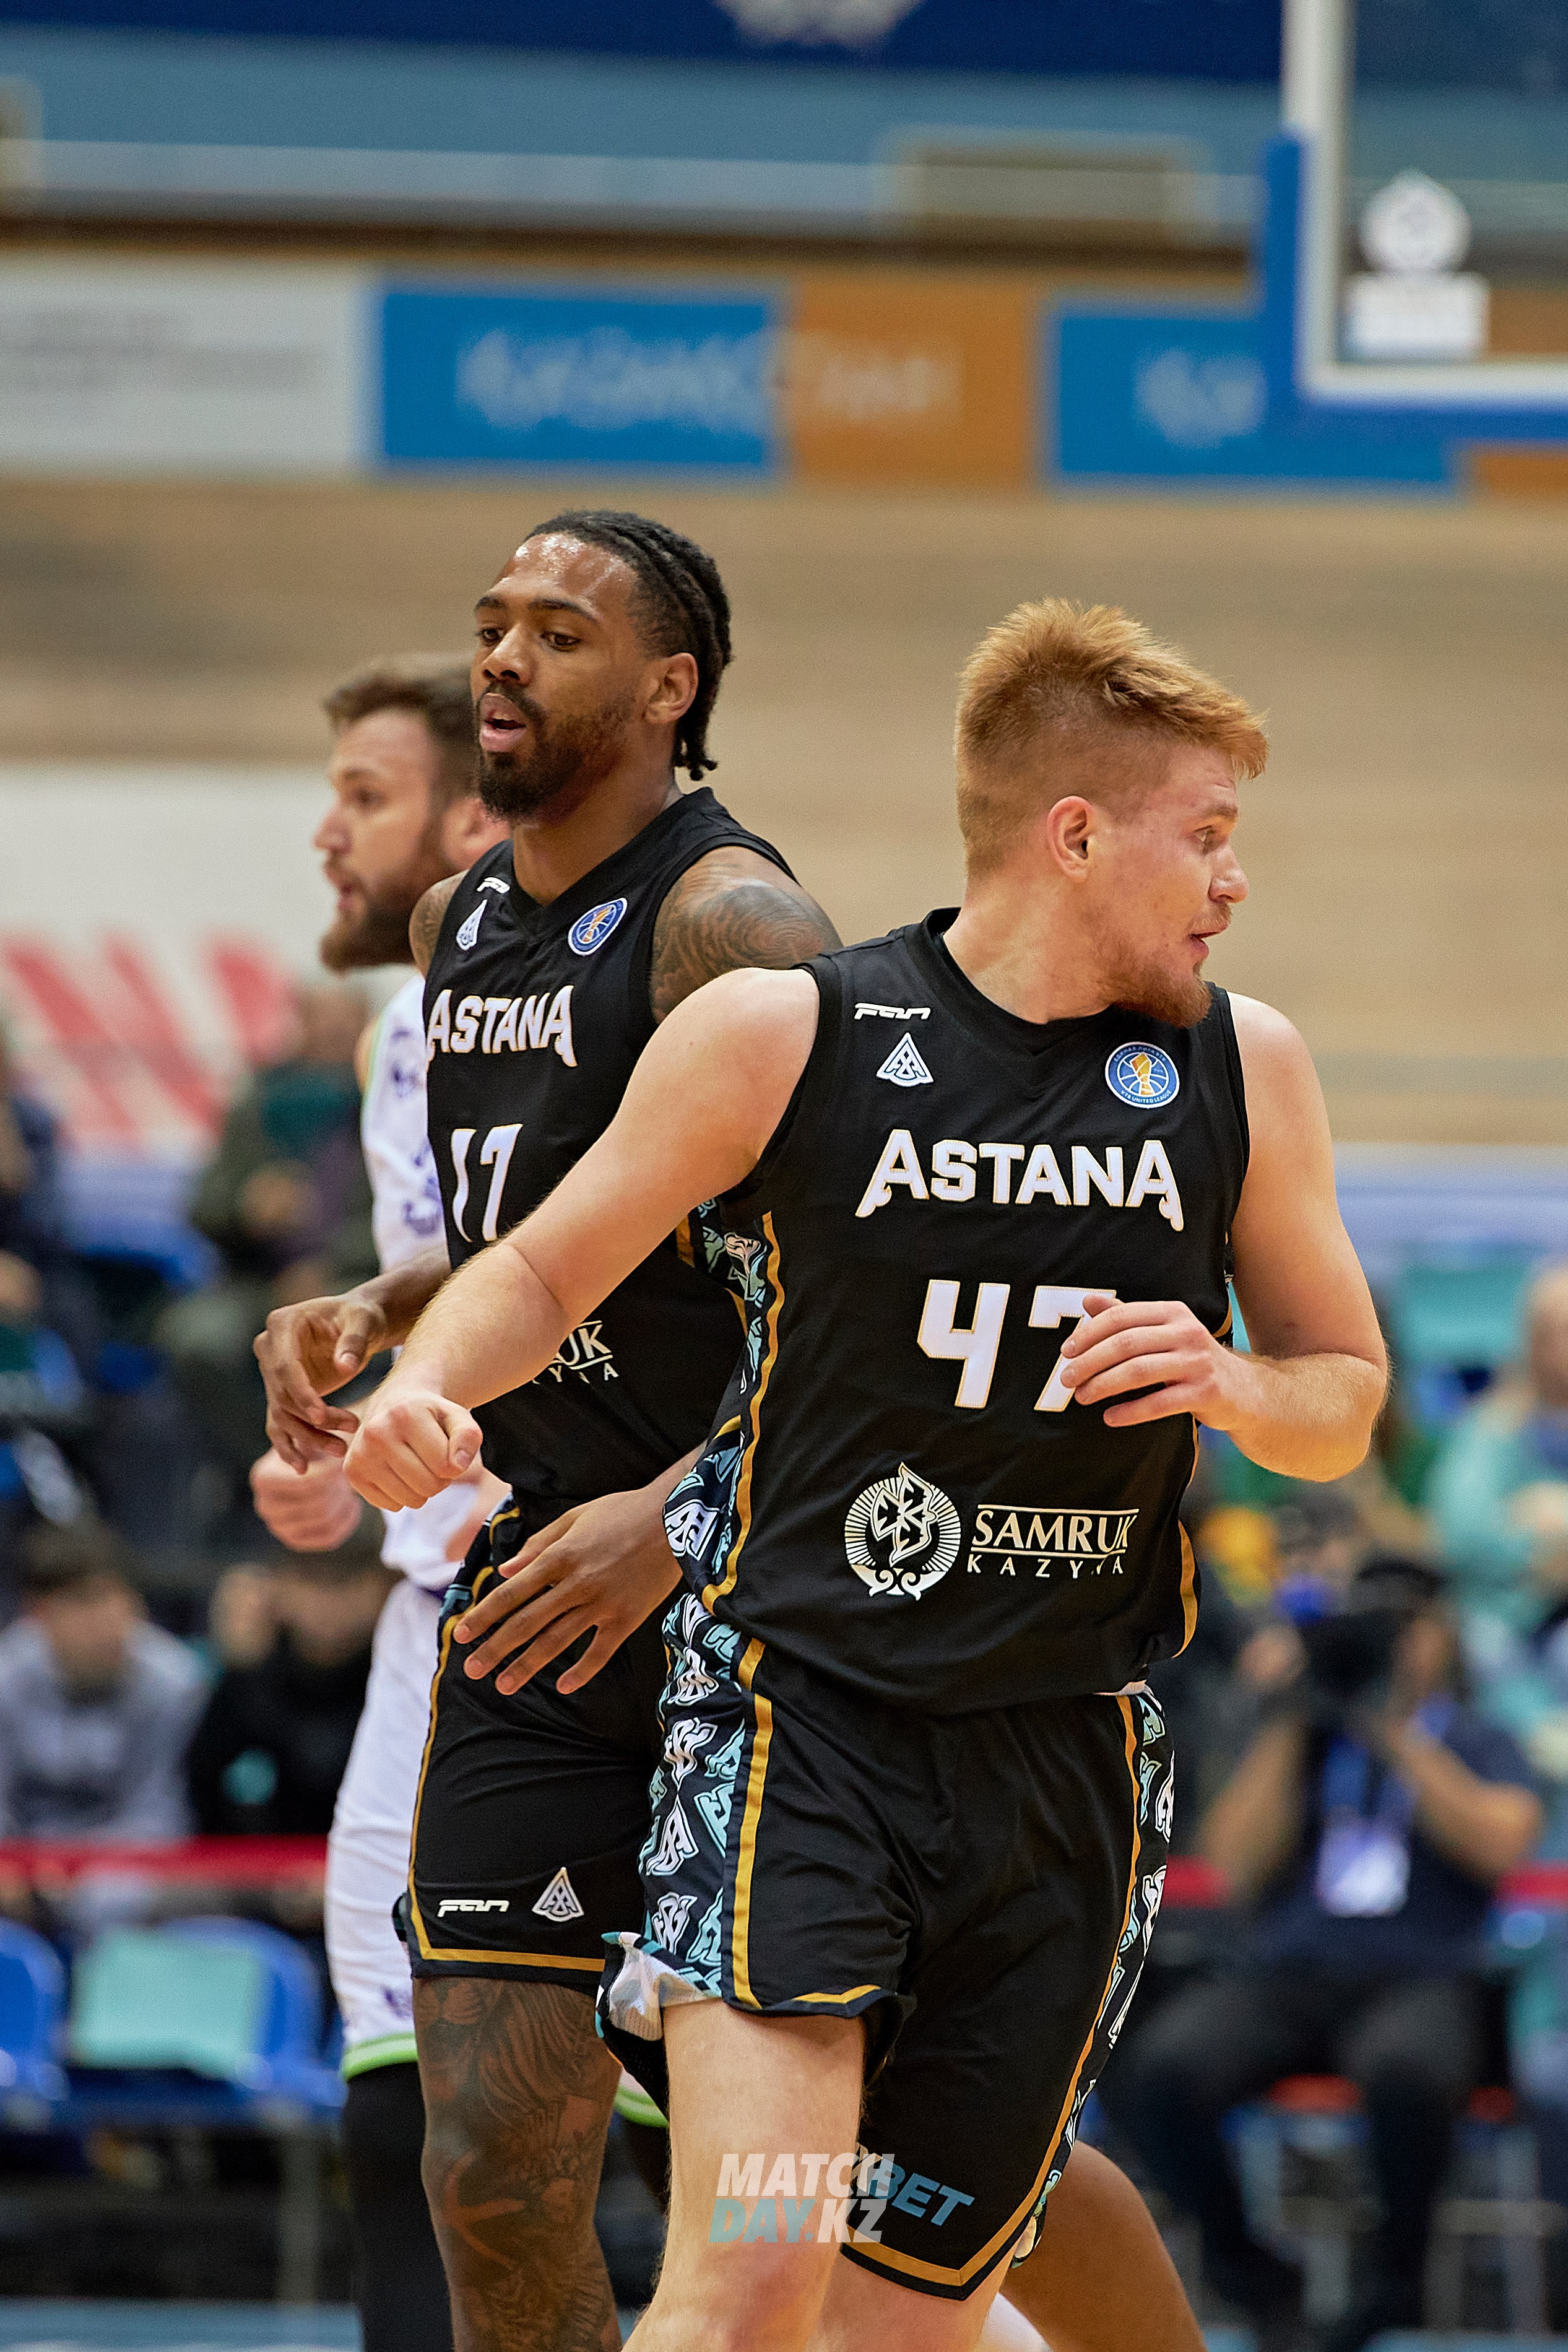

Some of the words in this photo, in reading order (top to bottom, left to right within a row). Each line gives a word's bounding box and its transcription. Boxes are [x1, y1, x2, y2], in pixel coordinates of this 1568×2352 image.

[426, 985, 578, 1072] ASTANA
[451, 1123, 523, 1243] 17
[855, 1129, 1184, 1232] ASTANA
[917, 1278, 1117, 1412] 47
[971, 1509, 1138, 1553] SAMRUK
